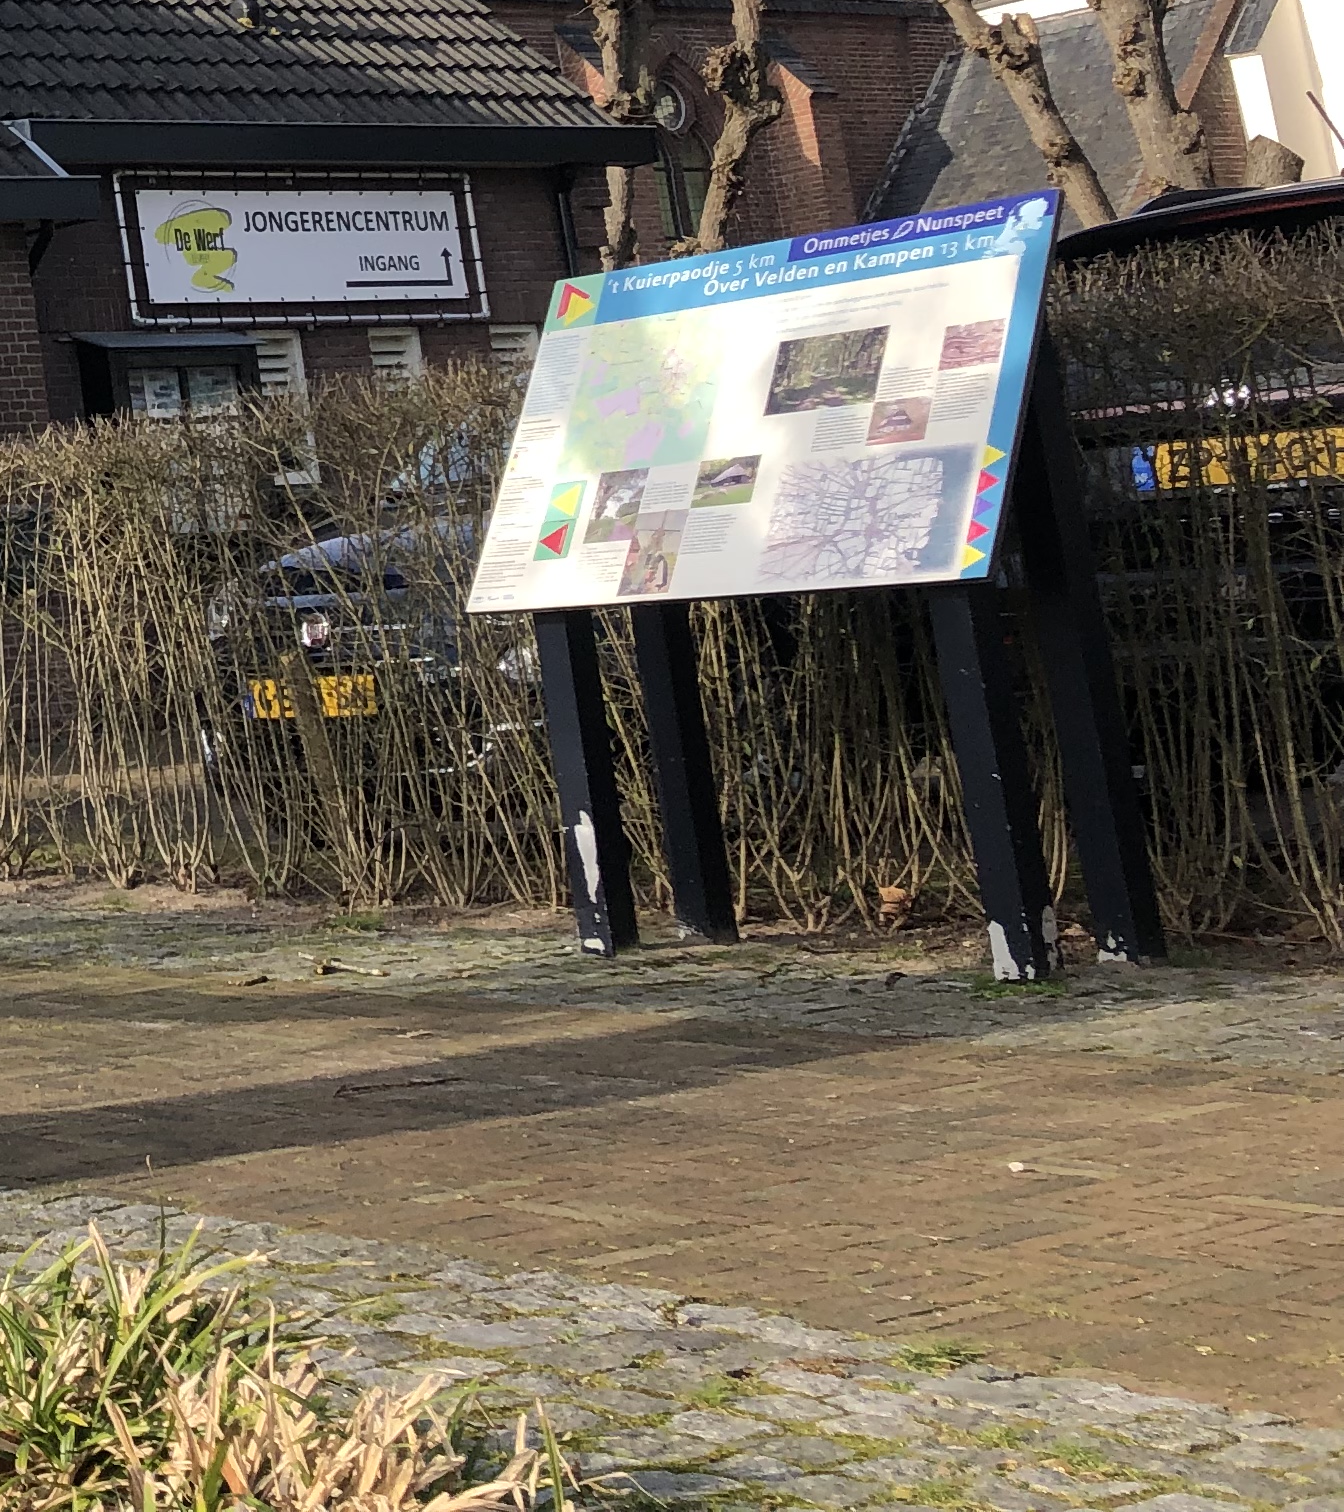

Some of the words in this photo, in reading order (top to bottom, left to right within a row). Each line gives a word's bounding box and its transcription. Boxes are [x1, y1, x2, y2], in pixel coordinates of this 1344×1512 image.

[243, 209, 451, 234] JONGERENCENTRUM
[803, 226, 890, 254] Ommetjes
[915, 204, 1004, 234] Nunspeet
[174, 228, 192, 252] De
[194, 227, 225, 252] Werf
[358, 253, 421, 273] INGANG
[623, 260, 730, 293] Kuierpaodje
[733, 260, 743, 276] 5
[748, 252, 776, 270] km
[703, 276, 750, 296] Over
[755, 264, 819, 287] Velden
[823, 260, 849, 276] en
[853, 244, 935, 271] Kampen
[939, 241, 959, 260] 13
[964, 231, 995, 251] km
